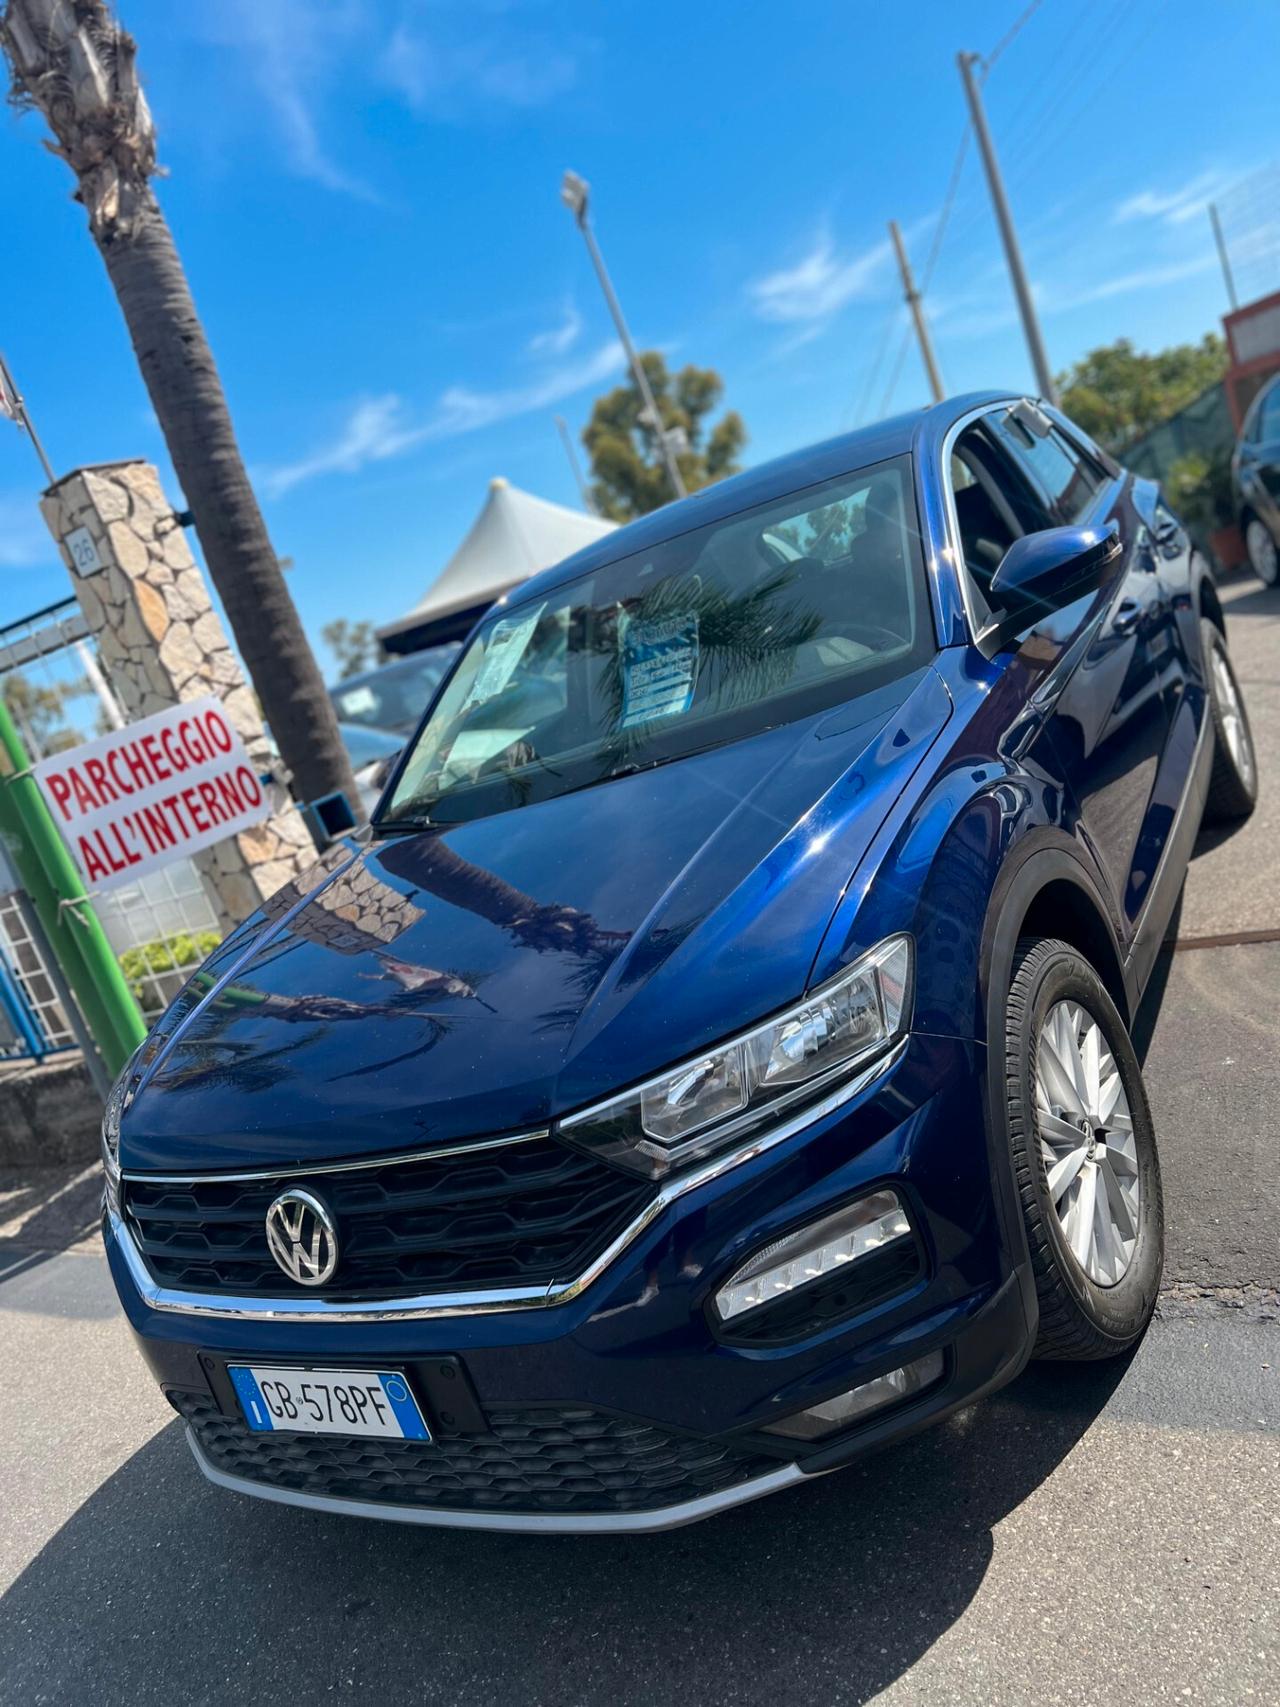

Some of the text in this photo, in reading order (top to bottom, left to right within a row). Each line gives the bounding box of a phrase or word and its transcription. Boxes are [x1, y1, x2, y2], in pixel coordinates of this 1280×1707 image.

[72, 537, 95, 567] 26
[44, 709, 232, 821] PARCHEGGIO
[77, 765, 262, 882] ALL'INTERNO
[266, 1189, 338, 1286] VW
